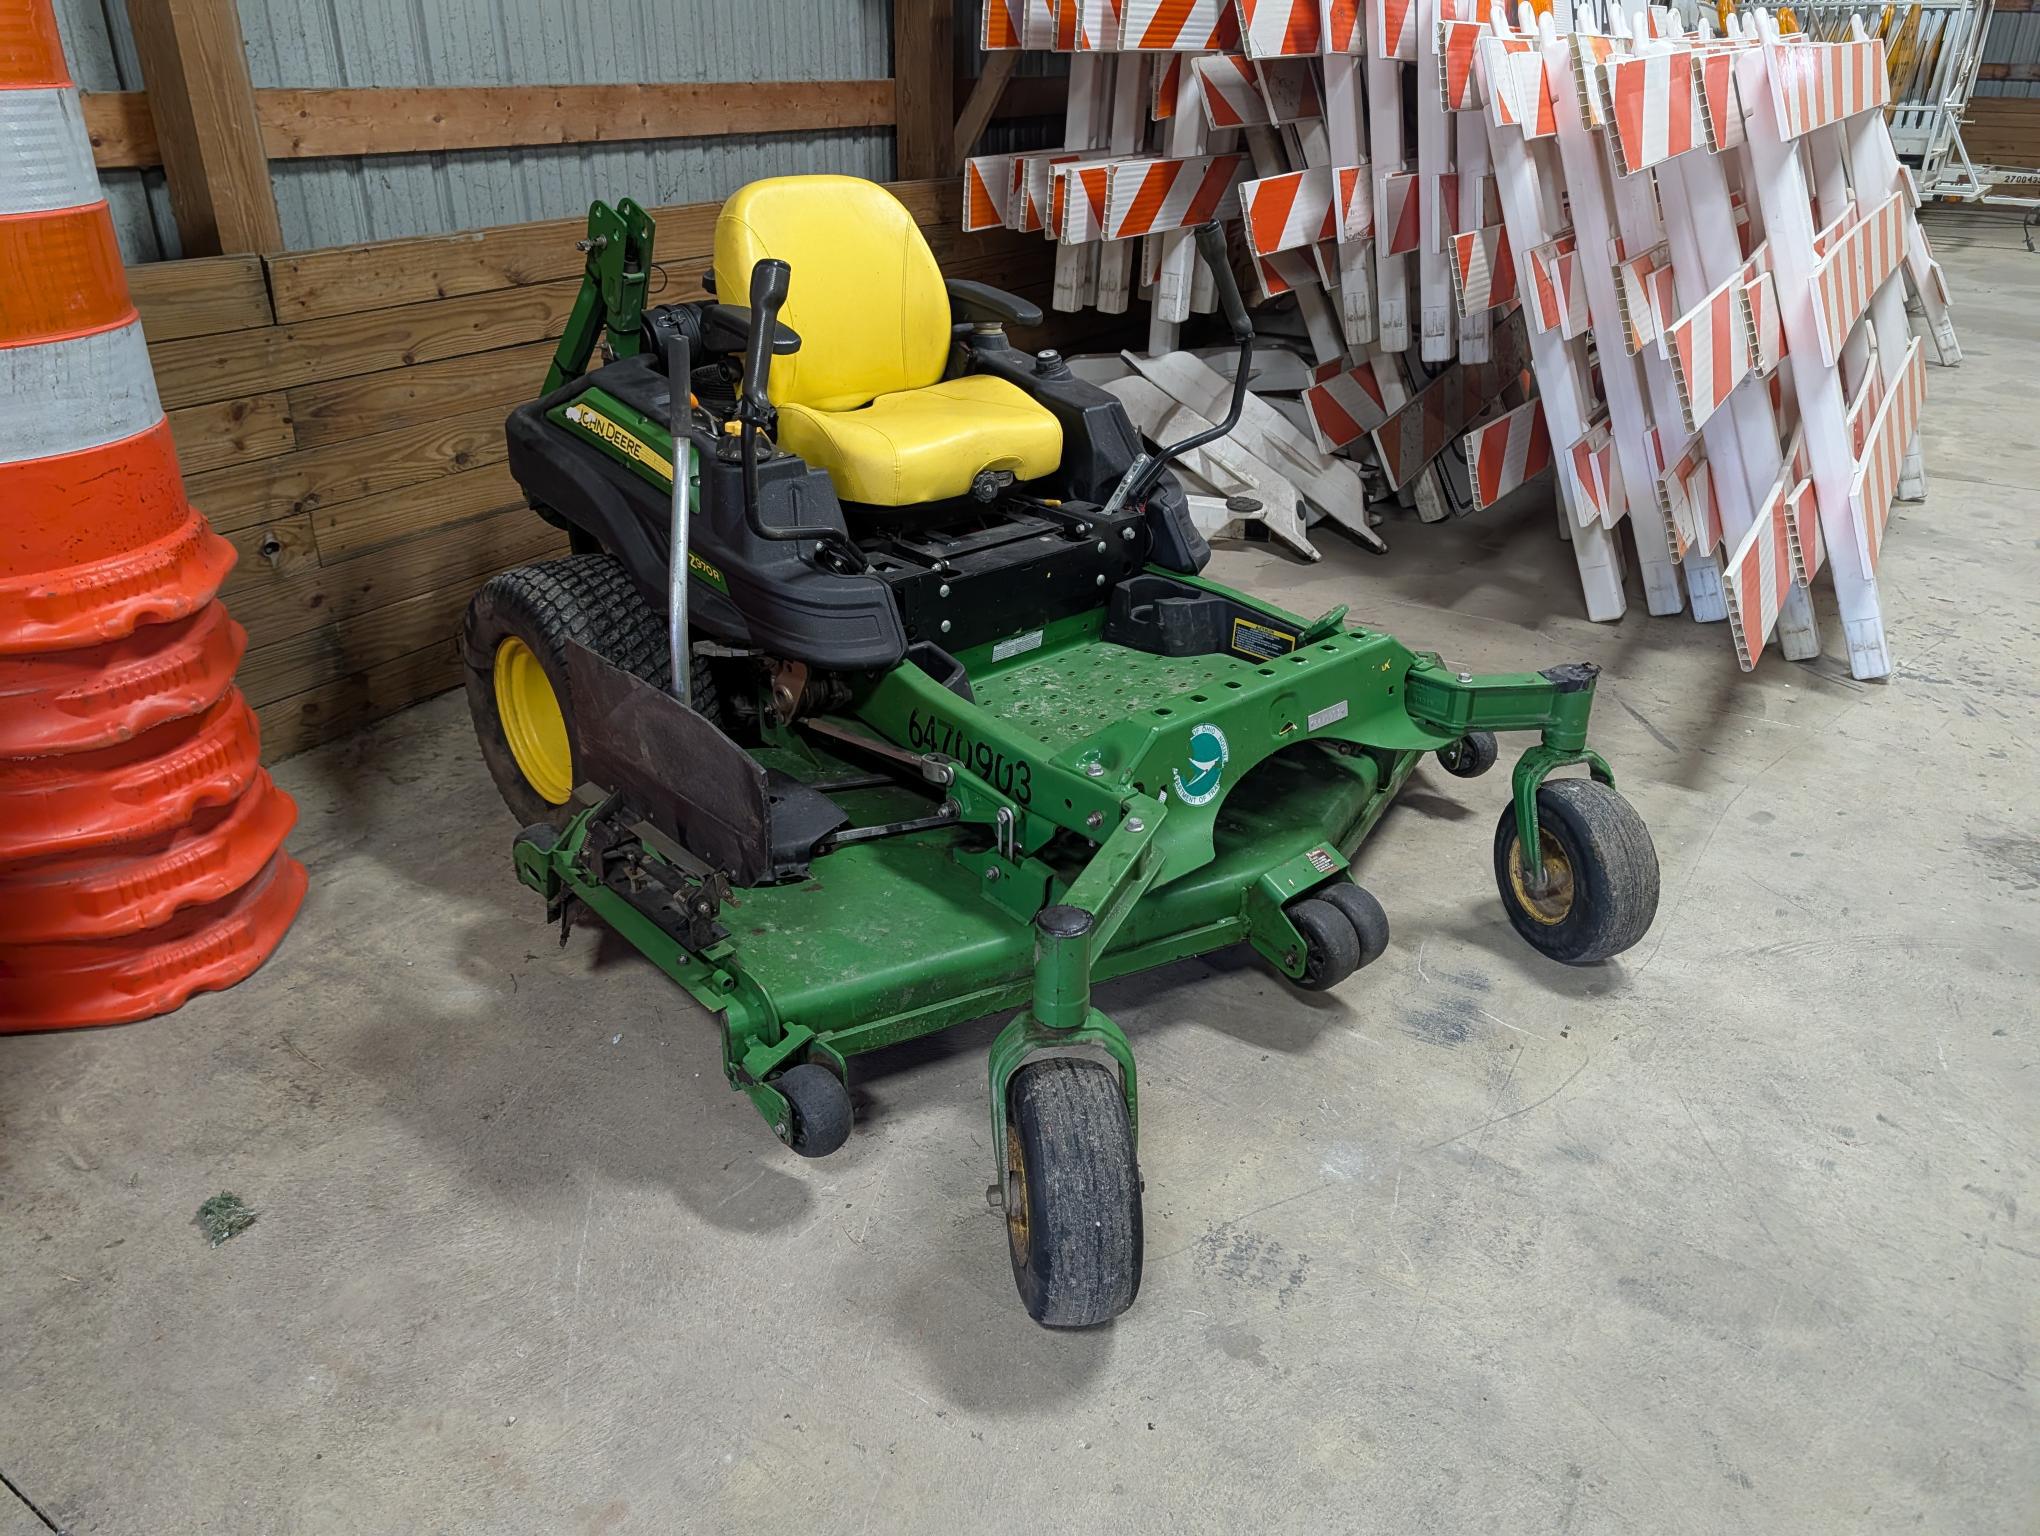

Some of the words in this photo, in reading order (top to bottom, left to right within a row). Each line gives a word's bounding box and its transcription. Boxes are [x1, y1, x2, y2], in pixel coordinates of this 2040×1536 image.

[605, 422, 642, 458] DEERE
[688, 553, 720, 582] Z970R
[909, 707, 1032, 805] 6470903
[1198, 795, 1207, 803] OF
